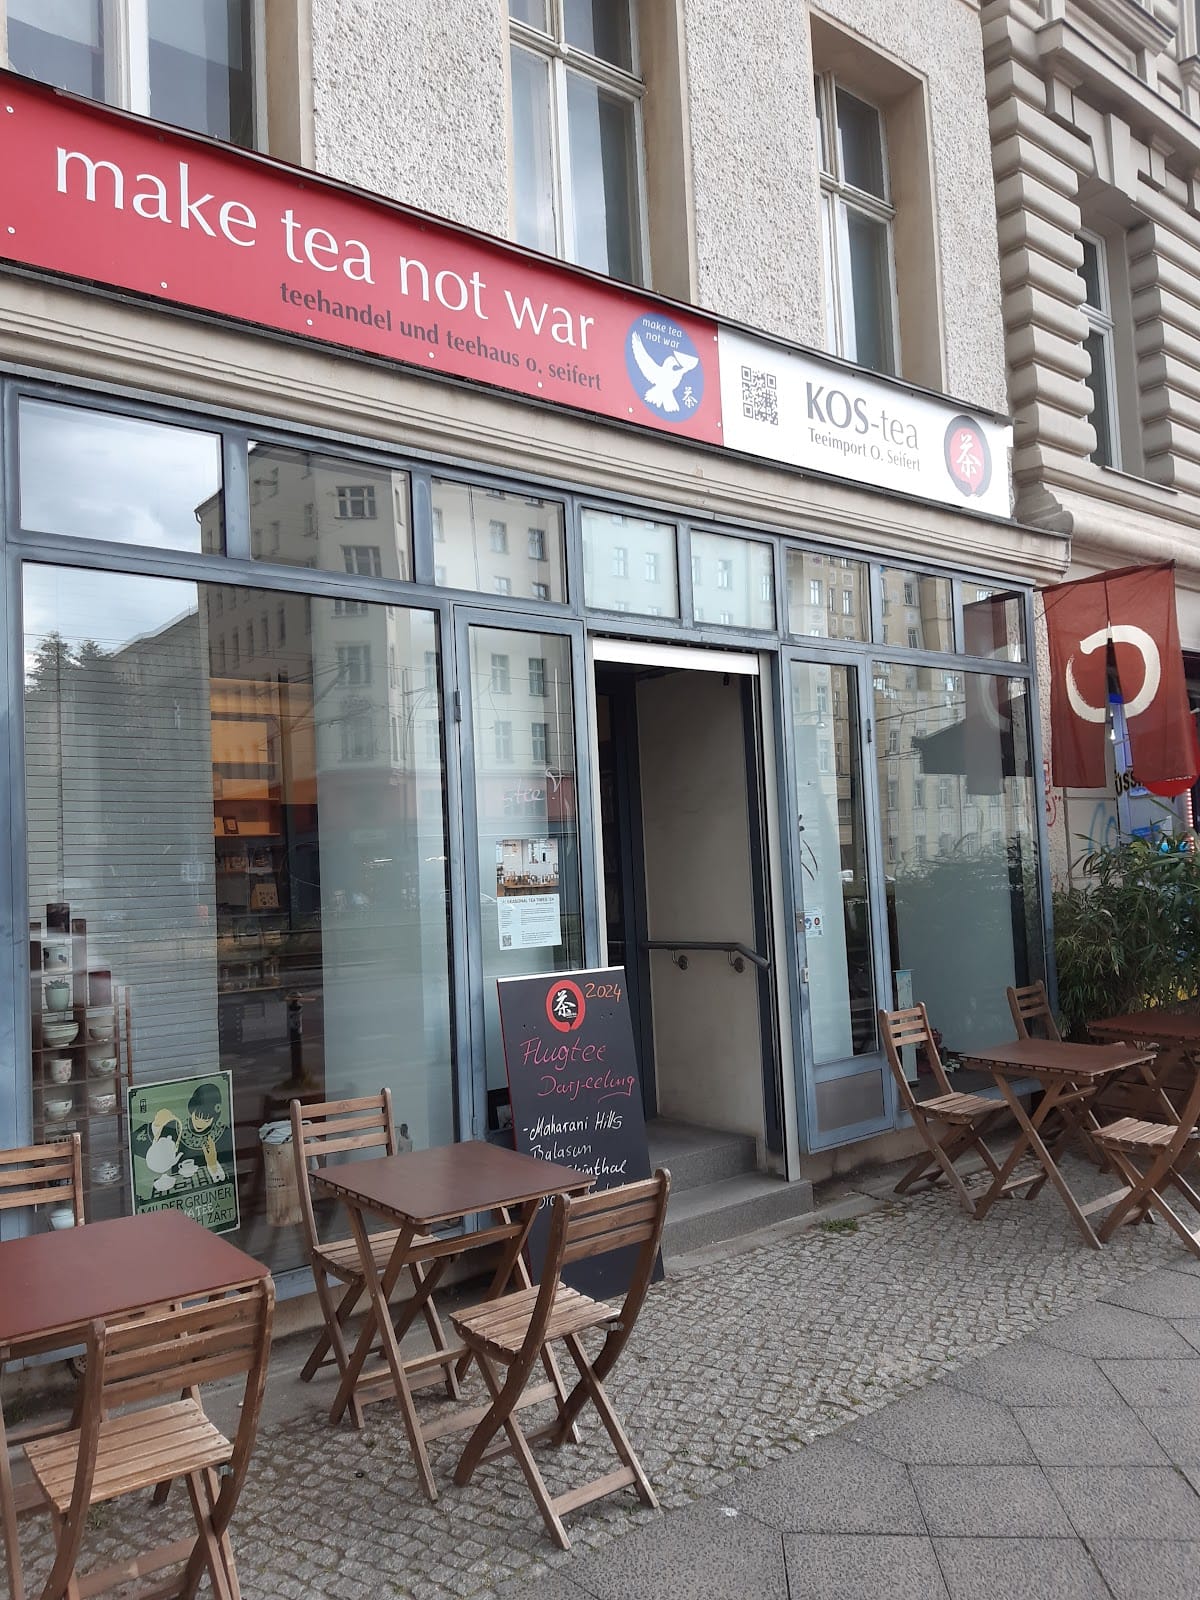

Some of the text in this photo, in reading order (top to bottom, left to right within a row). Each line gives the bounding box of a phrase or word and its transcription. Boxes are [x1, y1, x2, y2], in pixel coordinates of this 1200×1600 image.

[57, 147, 595, 350] make tea not war
[280, 282, 602, 391] teehandel und teehaus o. seifert
[642, 318, 683, 338] make tea
[645, 331, 681, 349] not war
[806, 381, 920, 450] KOS-tea
[808, 426, 920, 471] Teeimport O. Seifert
[585, 983, 621, 1003] 2024
[520, 1036, 606, 1071] Flugtee
[594, 1109, 623, 1131] Hills
[207, 1207, 234, 1224] ZART
